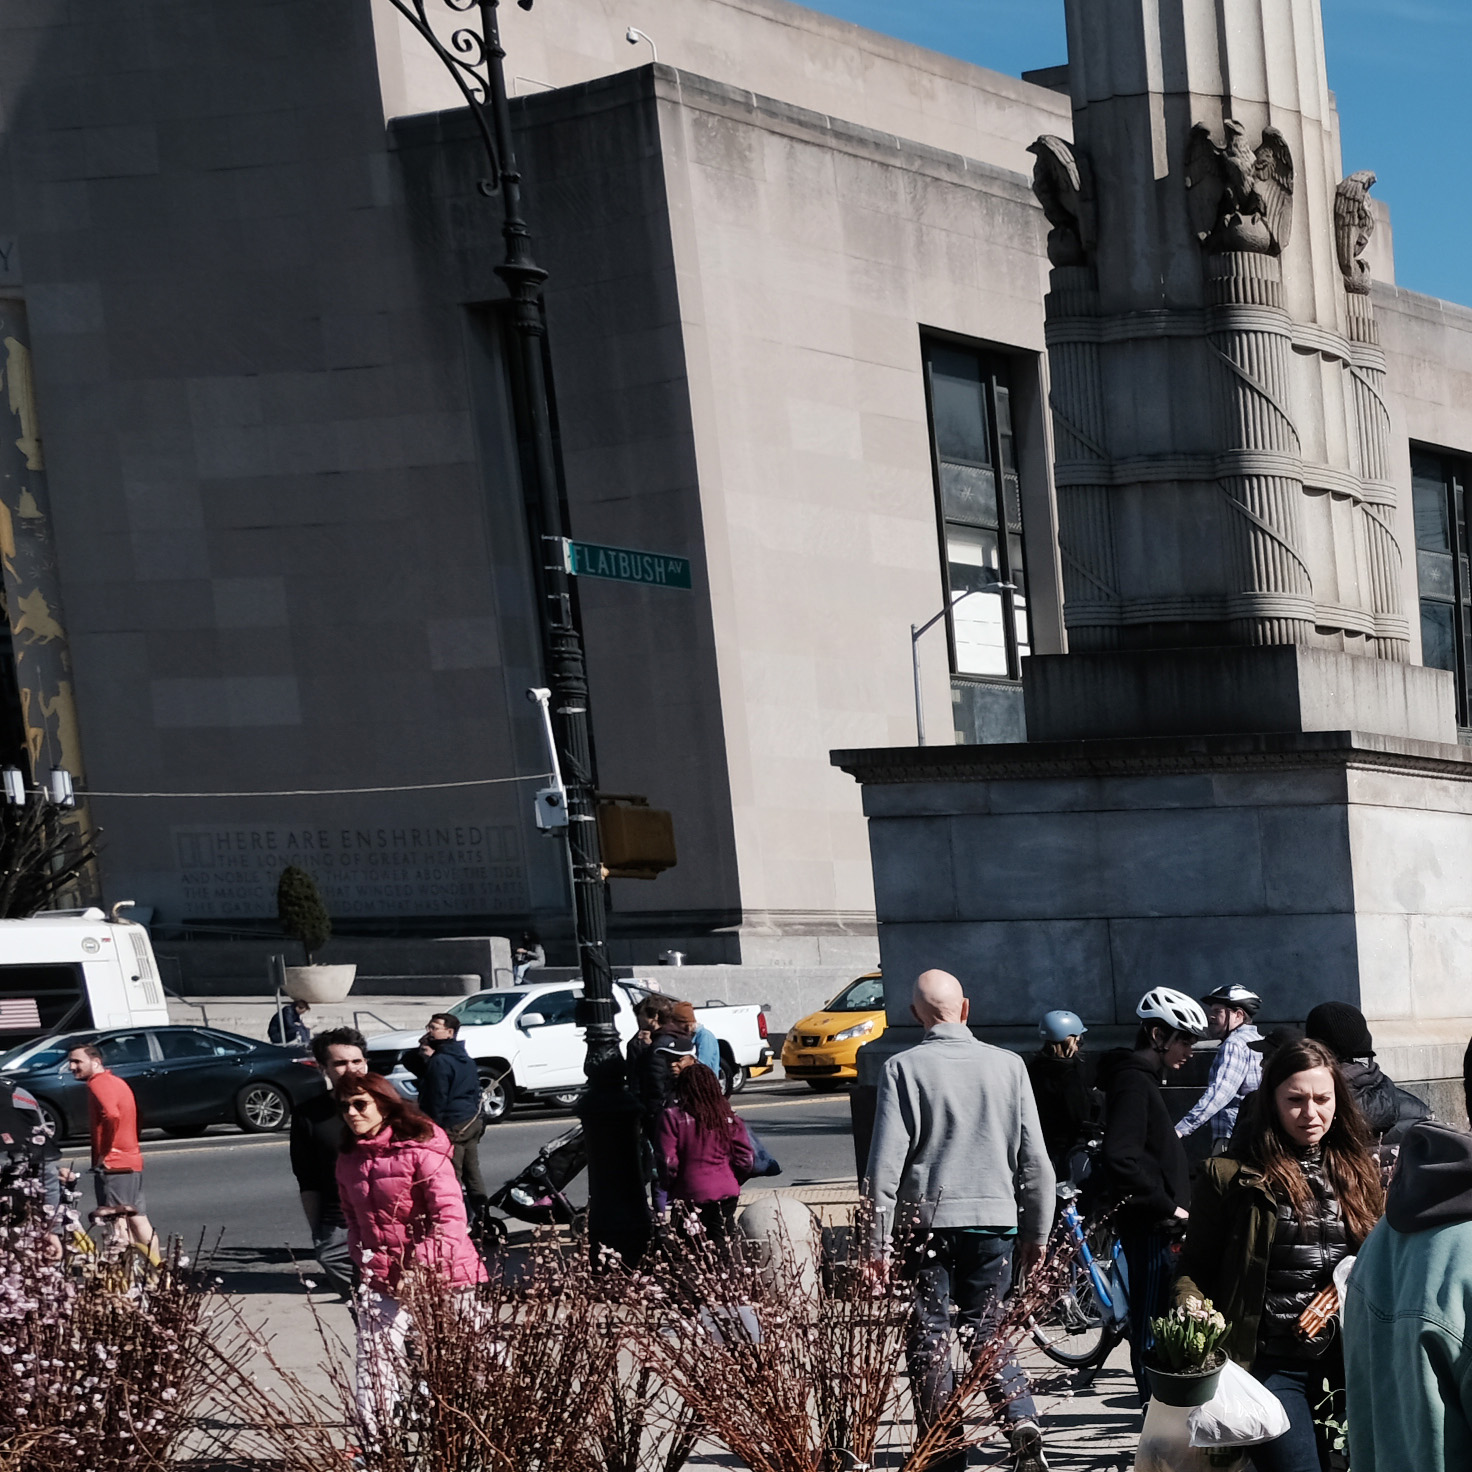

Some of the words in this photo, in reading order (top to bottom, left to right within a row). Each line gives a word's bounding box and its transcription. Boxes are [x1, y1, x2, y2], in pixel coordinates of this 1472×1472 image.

[574, 546, 666, 583] FLATBUSH
[668, 561, 682, 573] AV
[217, 831, 277, 850] HERE
[287, 830, 329, 849] ARE
[341, 827, 483, 848] ENSHRINED
[217, 855, 249, 867] THE
[340, 854, 360, 865] OF
[368, 852, 417, 865] GREAT
[424, 850, 483, 864] HEARTS
